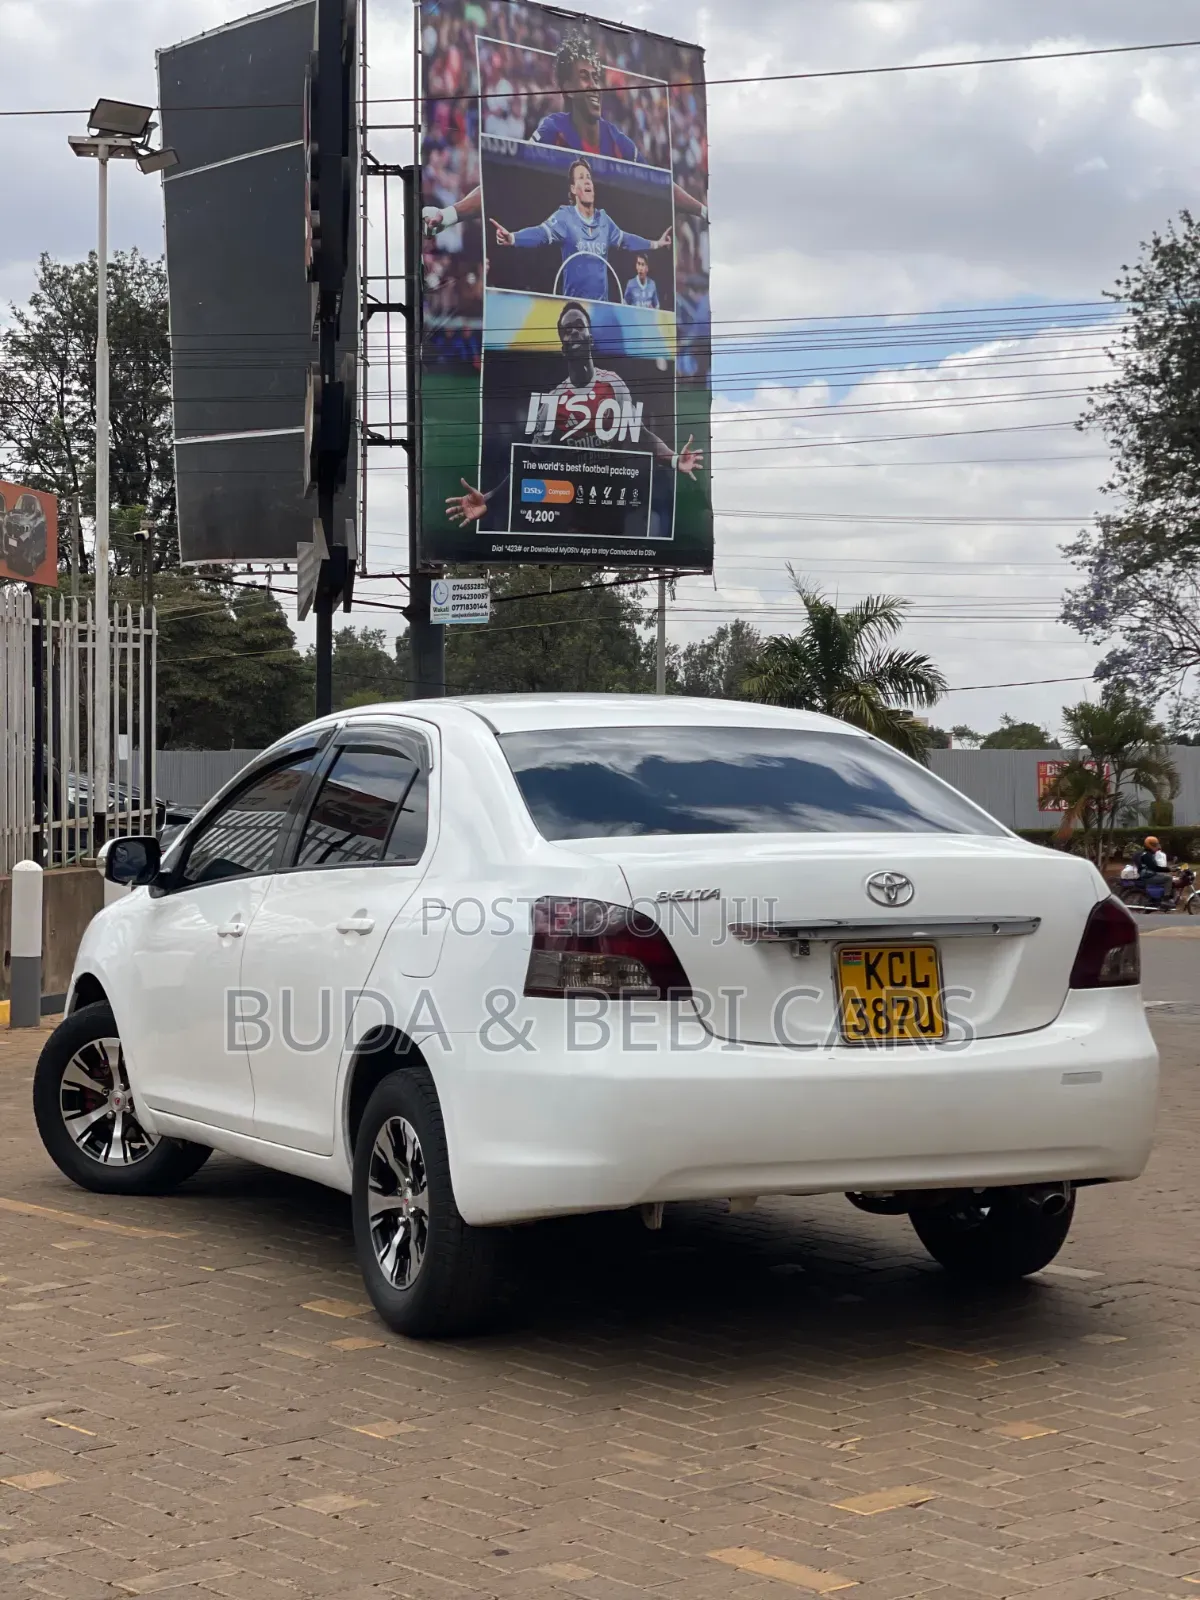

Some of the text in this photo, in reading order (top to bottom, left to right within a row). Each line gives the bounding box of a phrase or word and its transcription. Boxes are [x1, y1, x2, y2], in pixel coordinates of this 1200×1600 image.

[524, 392, 644, 443] IT'S ON
[522, 460, 639, 479] The world's best football package
[523, 487, 571, 496] DStv Compact
[525, 509, 555, 524] 4,200
[530, 545, 559, 554] Download
[580, 547, 591, 556] App
[597, 548, 609, 557] stay
[610, 548, 638, 556] Connected
[644, 549, 657, 557] DStv
[654, 887, 721, 904] BELTA
[864, 950, 931, 991] KCL
